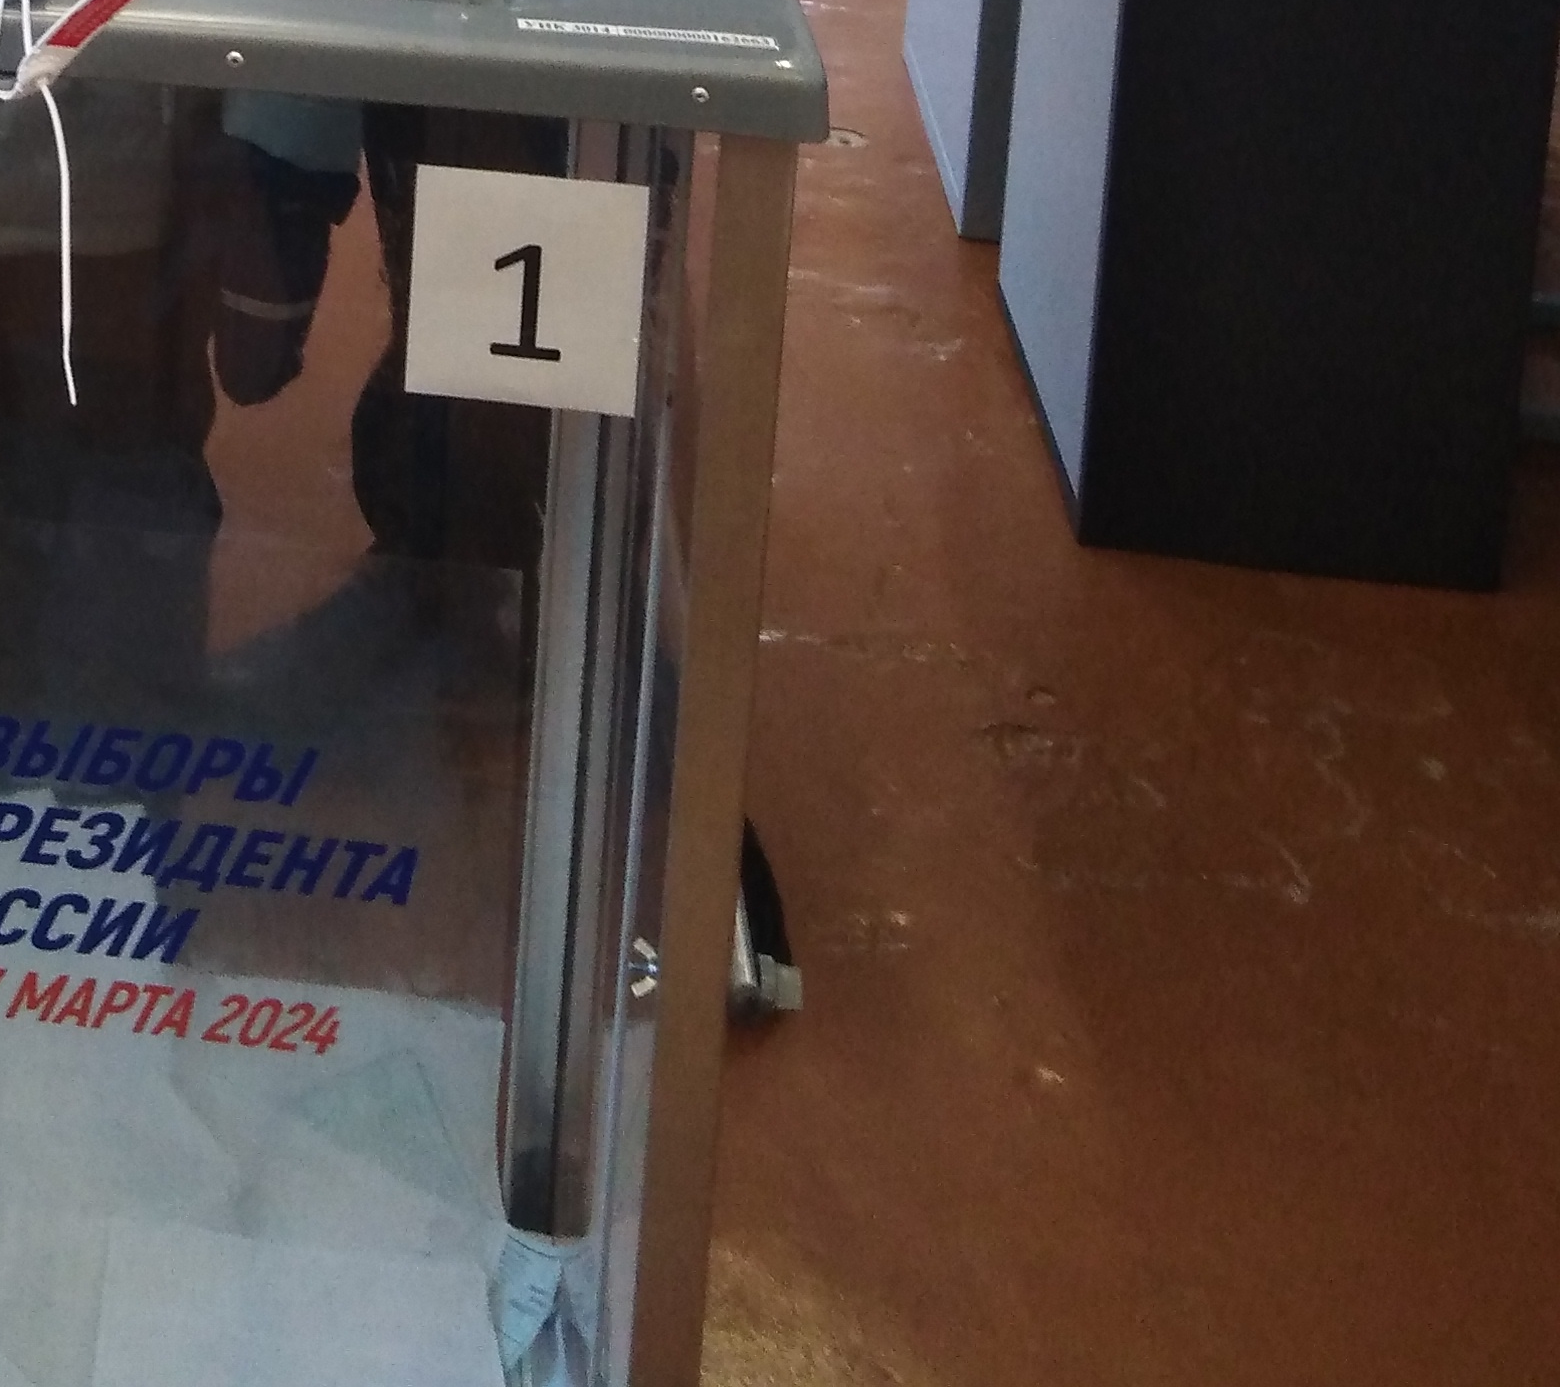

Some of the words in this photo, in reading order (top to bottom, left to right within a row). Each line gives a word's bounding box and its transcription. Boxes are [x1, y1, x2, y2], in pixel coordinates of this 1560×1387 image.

[490, 244, 561, 361] 1
[5, 970, 197, 1040] МАРТА
[200, 993, 343, 1056] 2024
